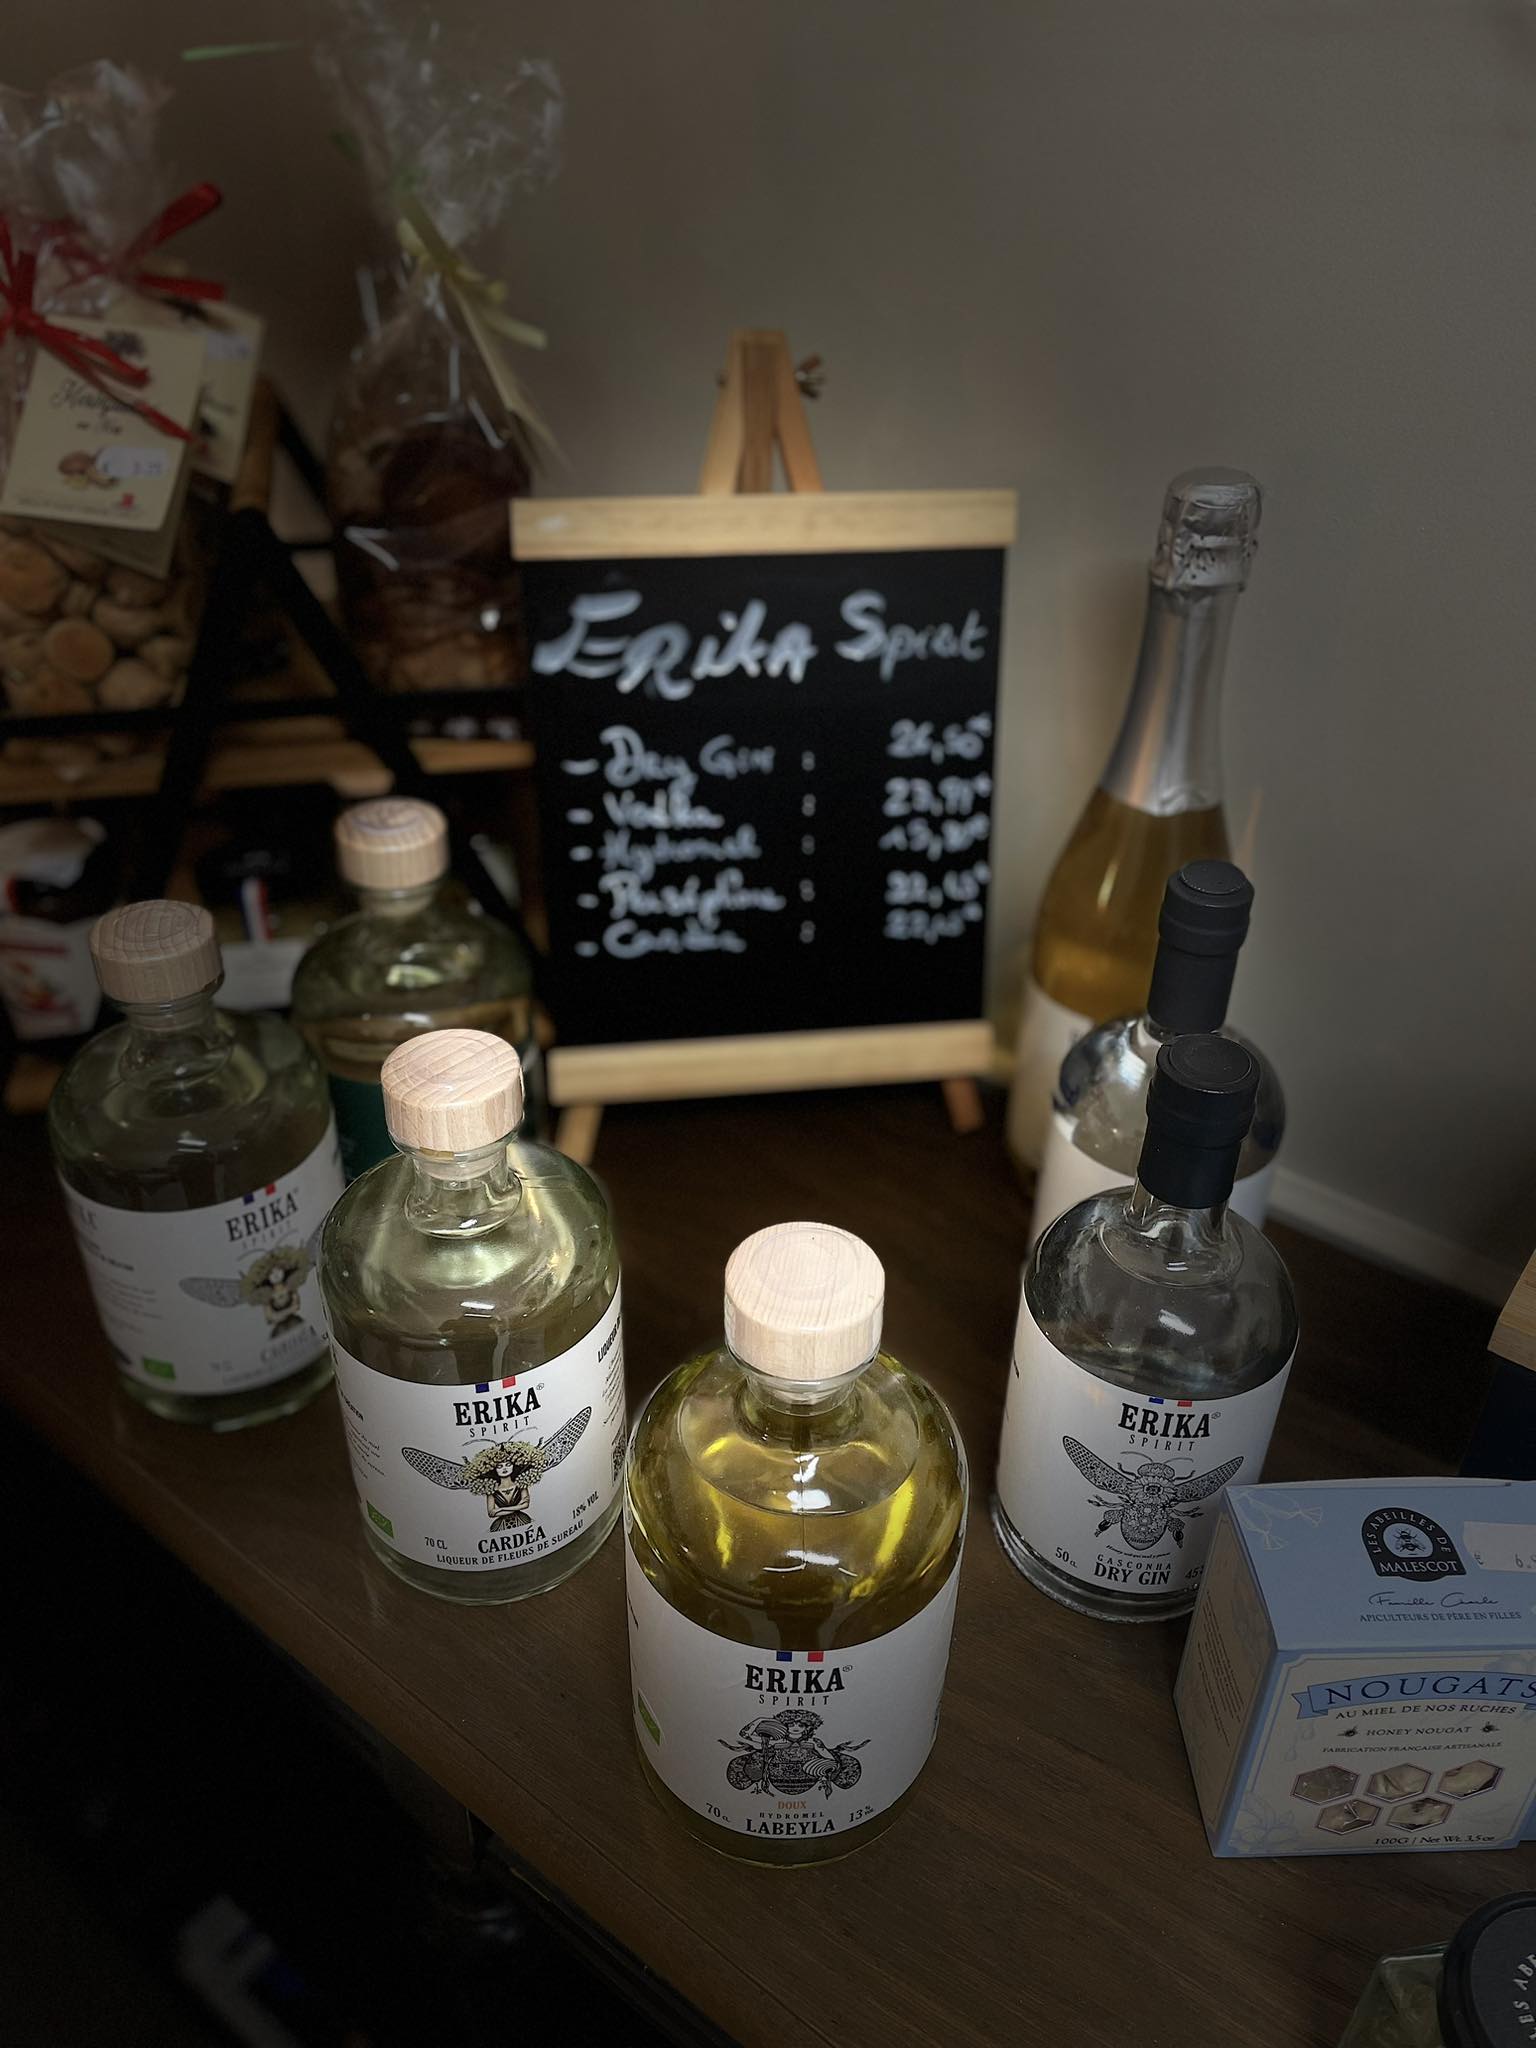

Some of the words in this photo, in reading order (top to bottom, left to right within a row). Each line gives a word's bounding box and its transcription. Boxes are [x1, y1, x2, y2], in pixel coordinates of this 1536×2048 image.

[469, 1415, 530, 1438] SPIRIT
[1128, 1434, 1196, 1452] SPIRIT
[1369, 1511, 1436, 1532] ABEILLES
[424, 1536, 436, 1549] 70
[436, 1539, 448, 1550] CL
[436, 1554, 478, 1565] LIQUEUR
[482, 1555, 495, 1564] DE
[497, 1546, 534, 1563] FLEURS
[537, 1540, 549, 1553] DE
[551, 1519, 584, 1546] SUREAU
[477, 1524, 547, 1554] CARDÉA
[1366, 1531, 1383, 1554] LES
[1436, 1536, 1452, 1553] DE
[1055, 1547, 1070, 1562] 50
[1094, 1562, 1133, 1584] DRY
[1138, 1571, 1172, 1585] GIN
[1379, 1560, 1458, 1573] MALESCOT
[1360, 1612, 1430, 1622] APICULTEURS
[1431, 1612, 1446, 1621] DE
[1447, 1611, 1473, 1621] PÈRE
[1473, 1611, 1488, 1620] EN
[1489, 1611, 1522, 1620] FILLES
[1325, 1676, 1536, 1704] NOUGATS
[759, 1694, 829, 1706] SPIRIT
[1335, 1710, 1357, 1720] AU
[1361, 1706, 1397, 1717] MIEL
[1401, 1705, 1422, 1713] DE
[1424, 1704, 1457, 1713] NOS
[1459, 1704, 1517, 1715] RUCHES
[1366, 1727, 1412, 1737] HONEY
[1415, 1726, 1473, 1735] NOUGAT
[706, 1802, 721, 1818] 70
[777, 1800, 807, 1810] DOUX
[759, 1811, 825, 1820] HYDROMEL
[745, 1818, 836, 1836] LABEYLA
